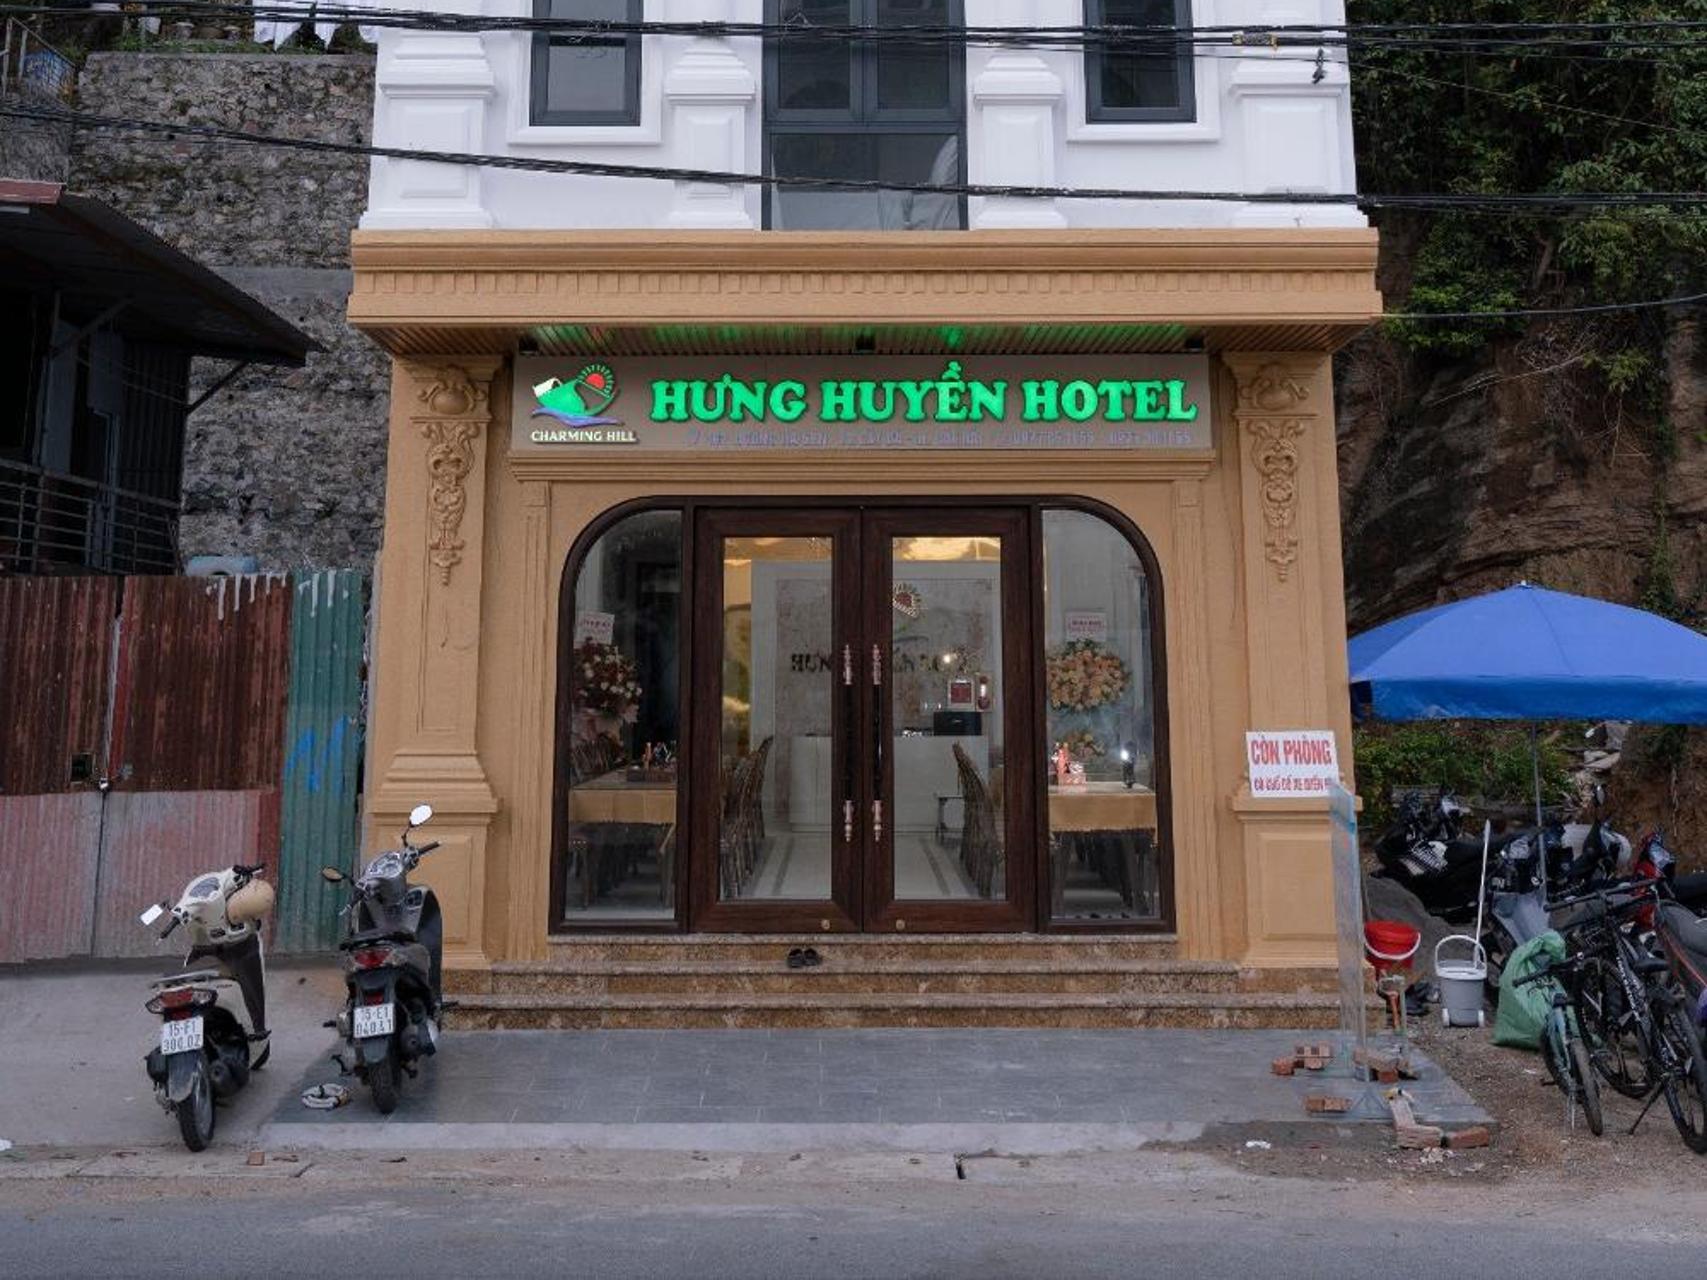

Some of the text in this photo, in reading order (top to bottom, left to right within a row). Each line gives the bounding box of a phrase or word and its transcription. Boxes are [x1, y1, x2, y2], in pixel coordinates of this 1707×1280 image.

[650, 361, 1198, 422] HƯNG HUYỀN HOTEL
[531, 429, 636, 442] CHARMING HILL
[1251, 734, 1332, 765] CÒN PHÒNG
